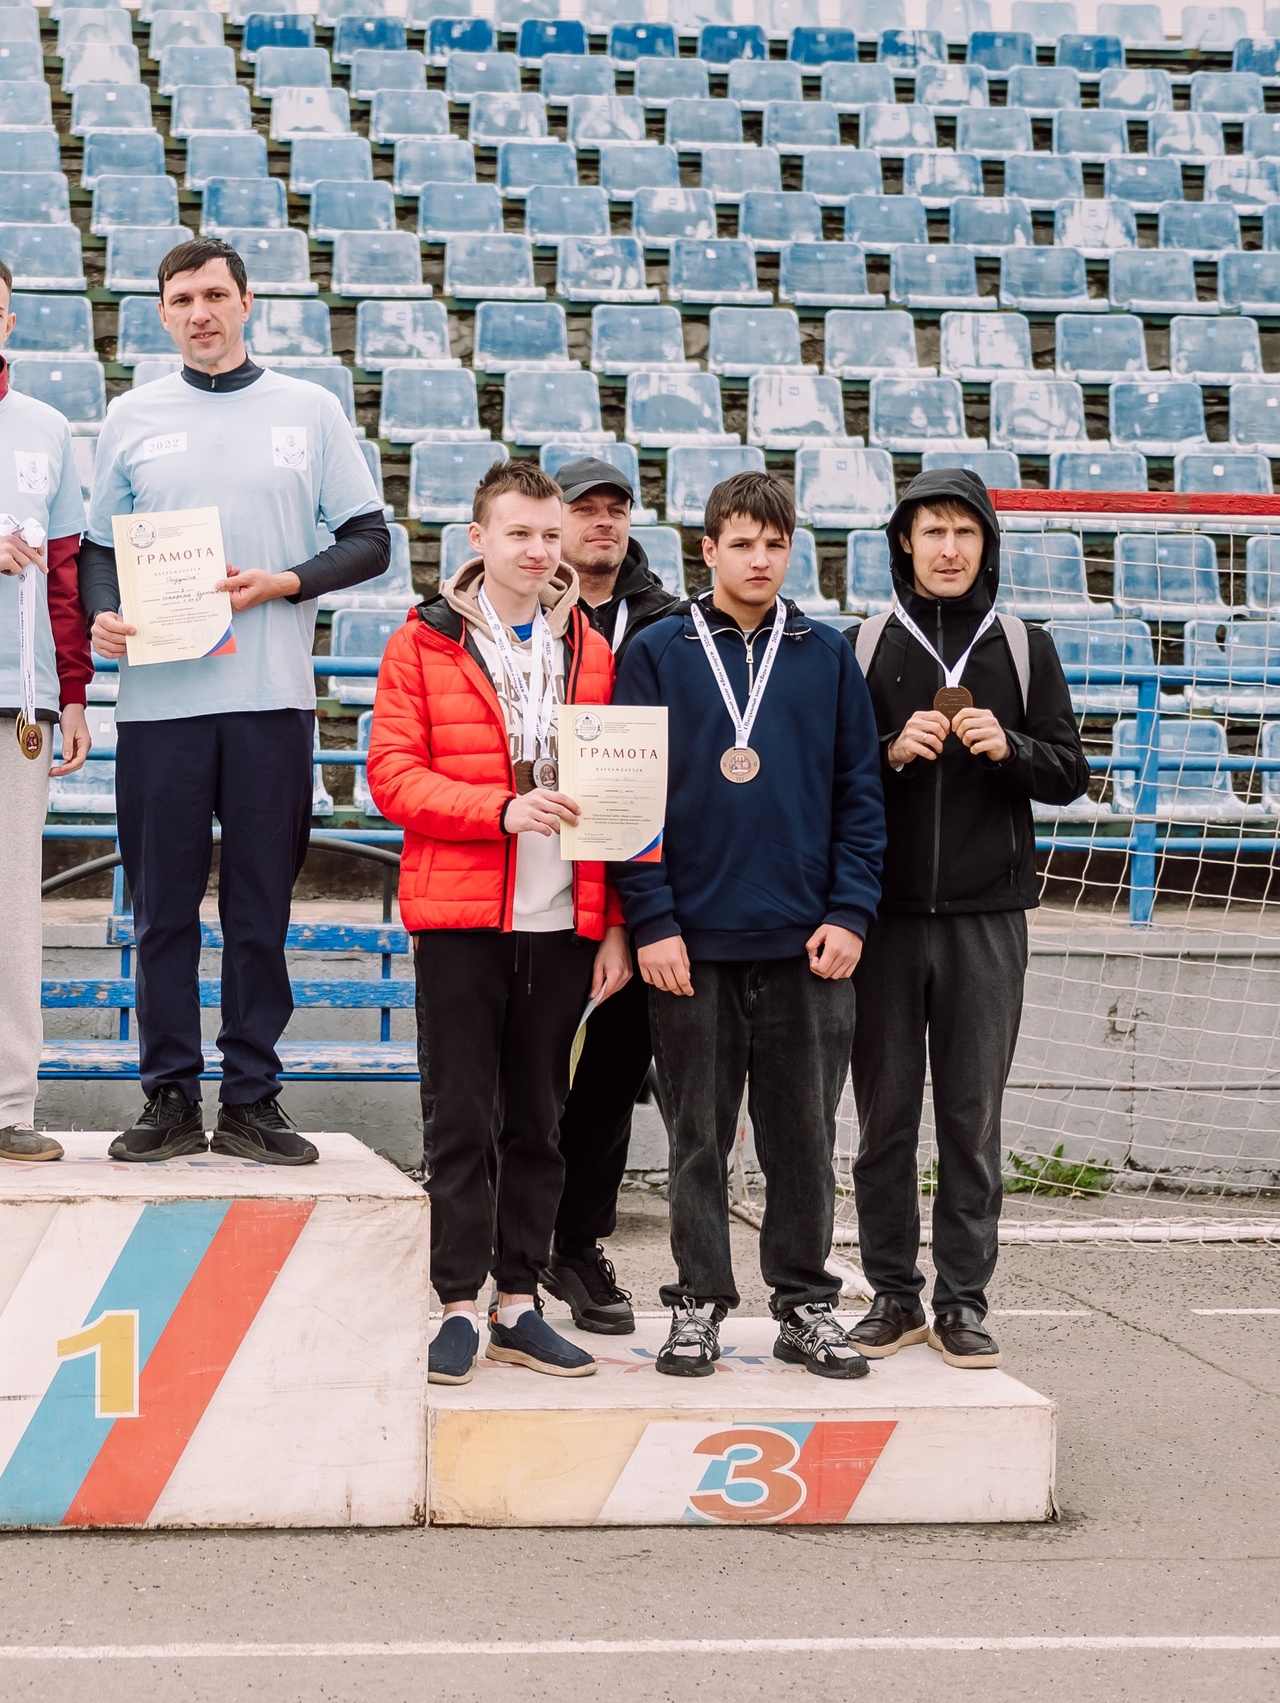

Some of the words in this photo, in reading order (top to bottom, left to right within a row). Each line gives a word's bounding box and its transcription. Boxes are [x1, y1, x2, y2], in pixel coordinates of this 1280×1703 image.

[149, 439, 180, 453] 2022
[137, 547, 214, 565] ГРАМОТА
[580, 747, 658, 760] ГРАМОТА
[57, 1309, 140, 1418] 1
[686, 1426, 808, 1523] 3
